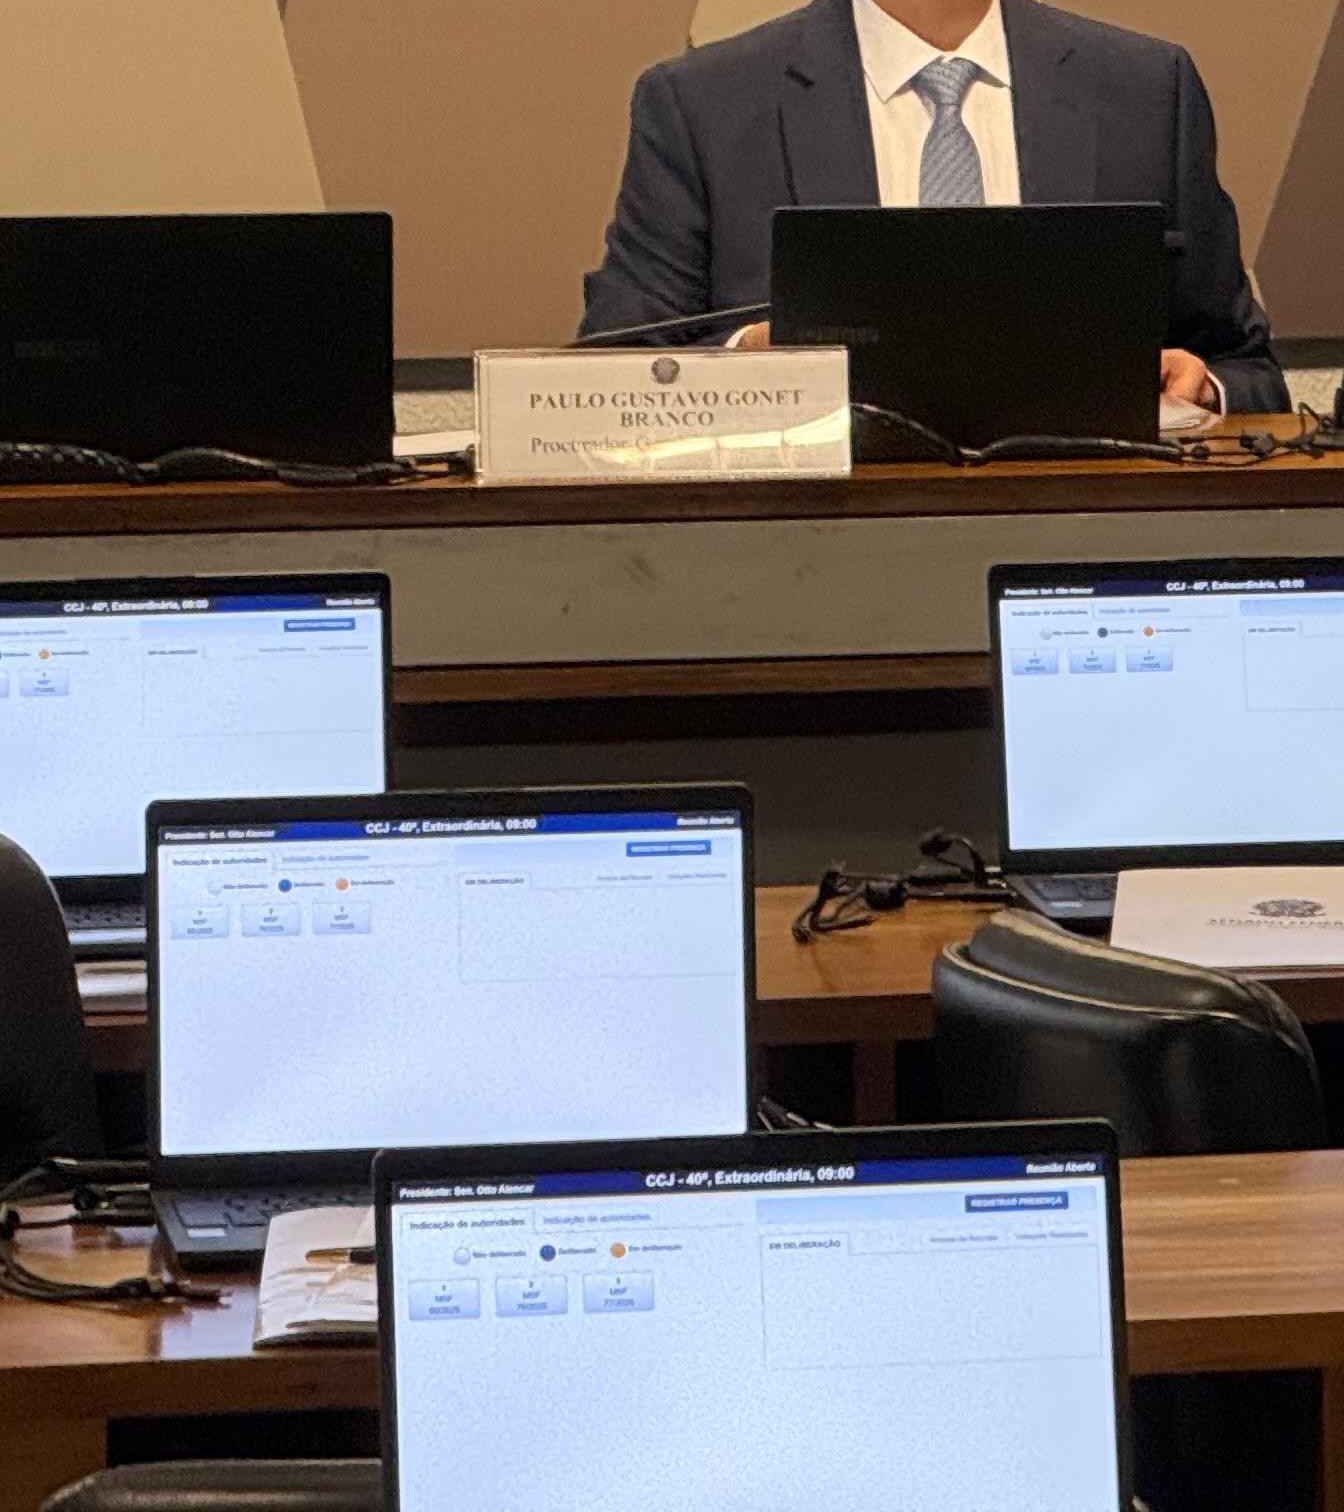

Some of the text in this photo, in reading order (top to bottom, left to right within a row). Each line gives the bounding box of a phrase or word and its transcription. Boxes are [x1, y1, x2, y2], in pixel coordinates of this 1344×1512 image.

[529, 389, 803, 409] PAULO GUSTAVO GONET
[619, 410, 716, 428] BRANCO
[365, 822, 390, 834] CCJ
[645, 1172, 675, 1188] CCJ
[715, 1168, 815, 1185] Extraordinária,
[817, 1166, 855, 1181] 09:00
